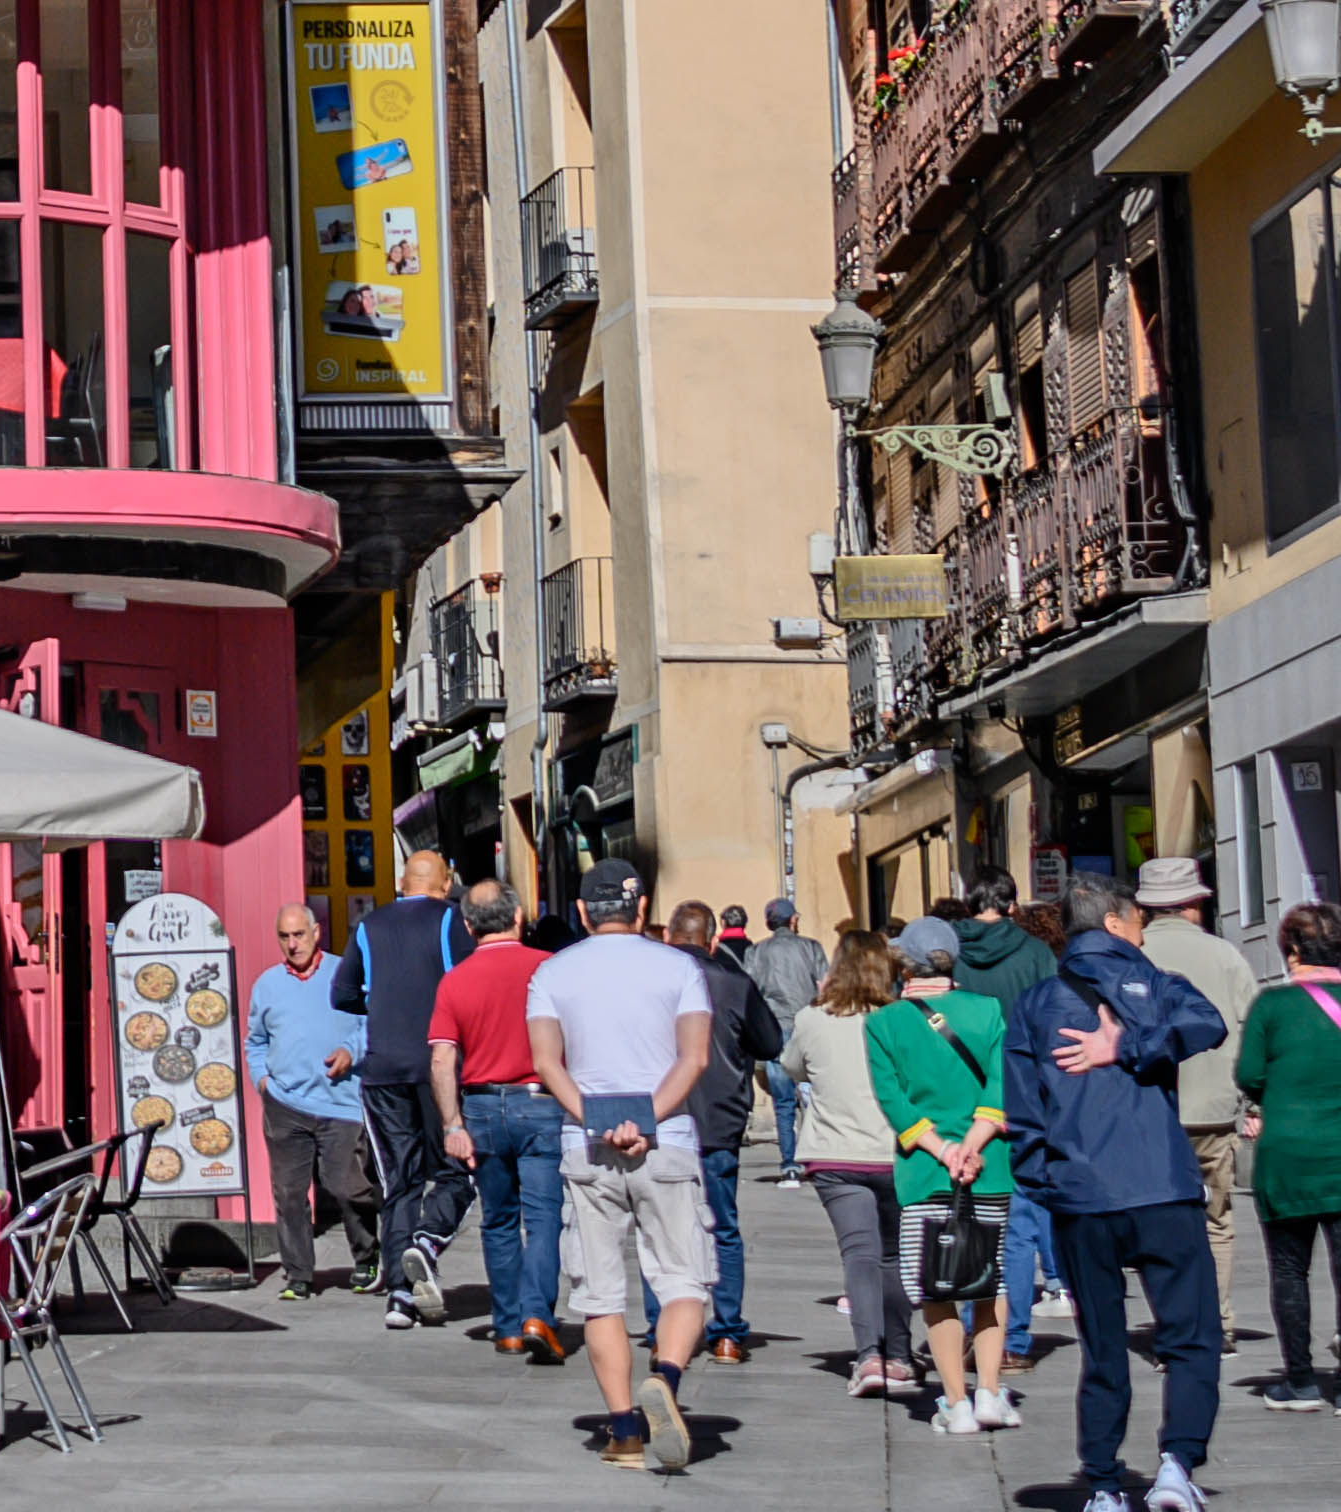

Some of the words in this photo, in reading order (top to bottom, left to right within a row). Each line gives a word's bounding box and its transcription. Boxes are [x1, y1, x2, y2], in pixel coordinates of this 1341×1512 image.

[303, 20, 414, 38] PERSONALIZA
[304, 43, 333, 70] TU
[339, 43, 416, 70] FUNDA
[355, 369, 429, 384] INSPIRAL
